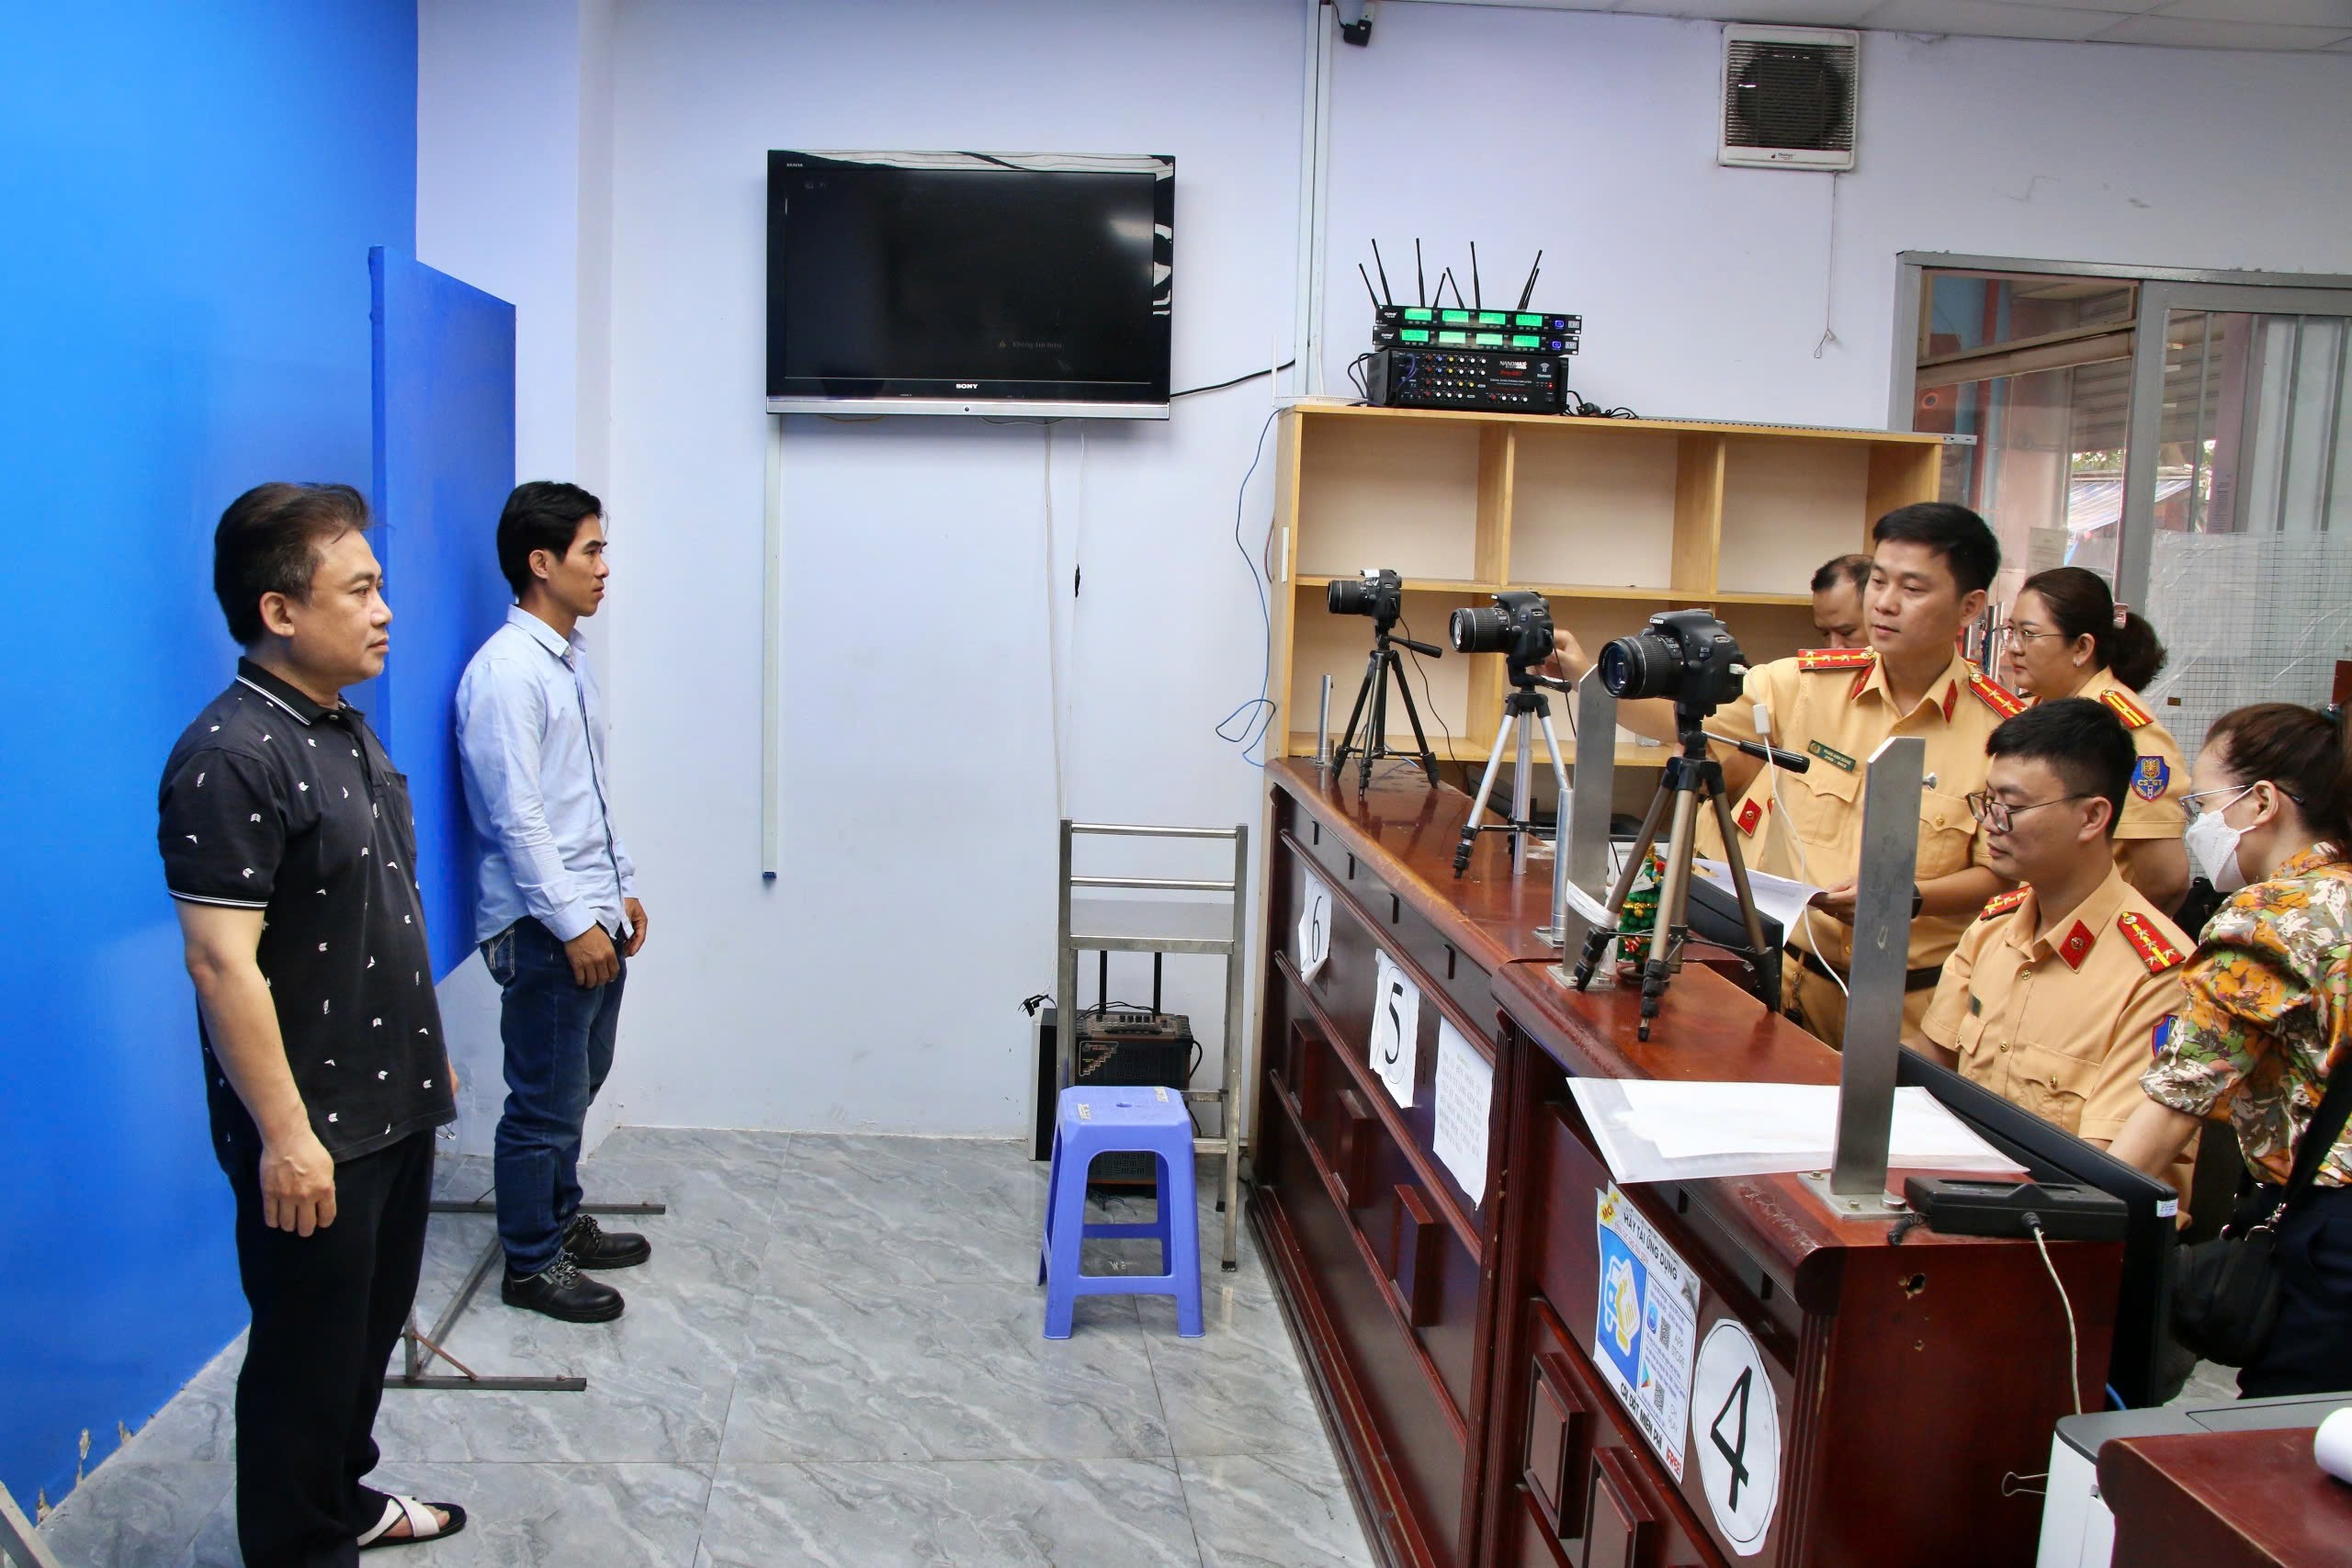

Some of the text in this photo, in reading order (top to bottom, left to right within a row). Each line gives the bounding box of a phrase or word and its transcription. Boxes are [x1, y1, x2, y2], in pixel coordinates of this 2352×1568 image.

[1311, 895, 1322, 964] 6
[1385, 981, 1404, 1065] 5
[1624, 1213, 1635, 1232] HÃY
[1645, 1234, 1659, 1259] ỨNG
[1660, 1253, 1677, 1280] DỤNG
[1709, 1365, 1753, 1514] 4
